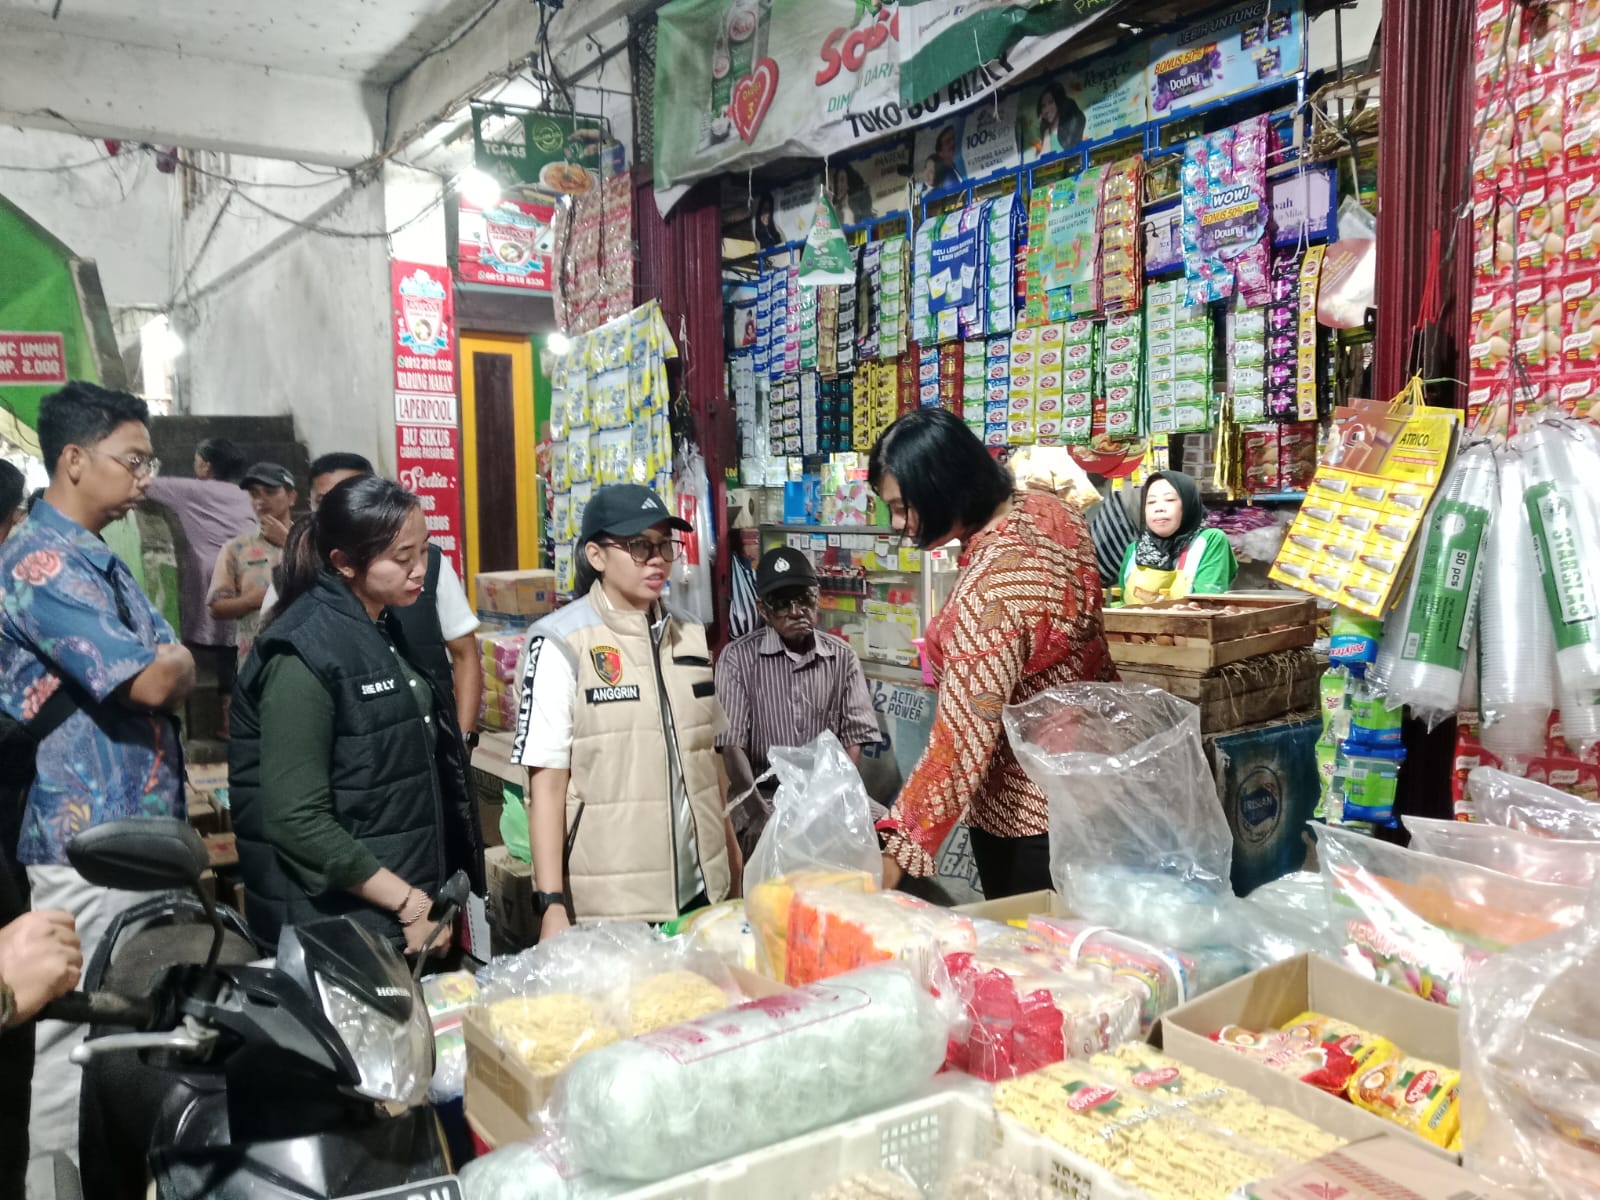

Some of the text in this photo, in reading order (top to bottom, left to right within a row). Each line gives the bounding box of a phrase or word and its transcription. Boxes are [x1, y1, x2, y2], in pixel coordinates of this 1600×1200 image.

[1155, 55, 1183, 75] BONUS
[1170, 73, 1200, 92] Downy
[849, 102, 901, 137] TOKO
[966, 129, 997, 149] 100%
[1213, 185, 1250, 208] WOW!
[1202, 211, 1227, 226] BONUS
[1214, 227, 1243, 240] Downy
[20, 342, 58, 357] UMUM
[397, 371, 453, 391] WARUNG MAKAN
[400, 398, 452, 421] LAPERPOOL
[402, 427, 450, 447] BU SIKUS
[1399, 432, 1430, 447] ATRICO
[1451, 551, 1468, 587] 50 pcs
[1330, 641, 1368, 657] Polytex
[593, 686, 637, 701] ANGGRIN
[890, 690, 925, 710] ACTIVE
[887, 703, 922, 721] POWER
[510, 686, 533, 763] HARLEY
